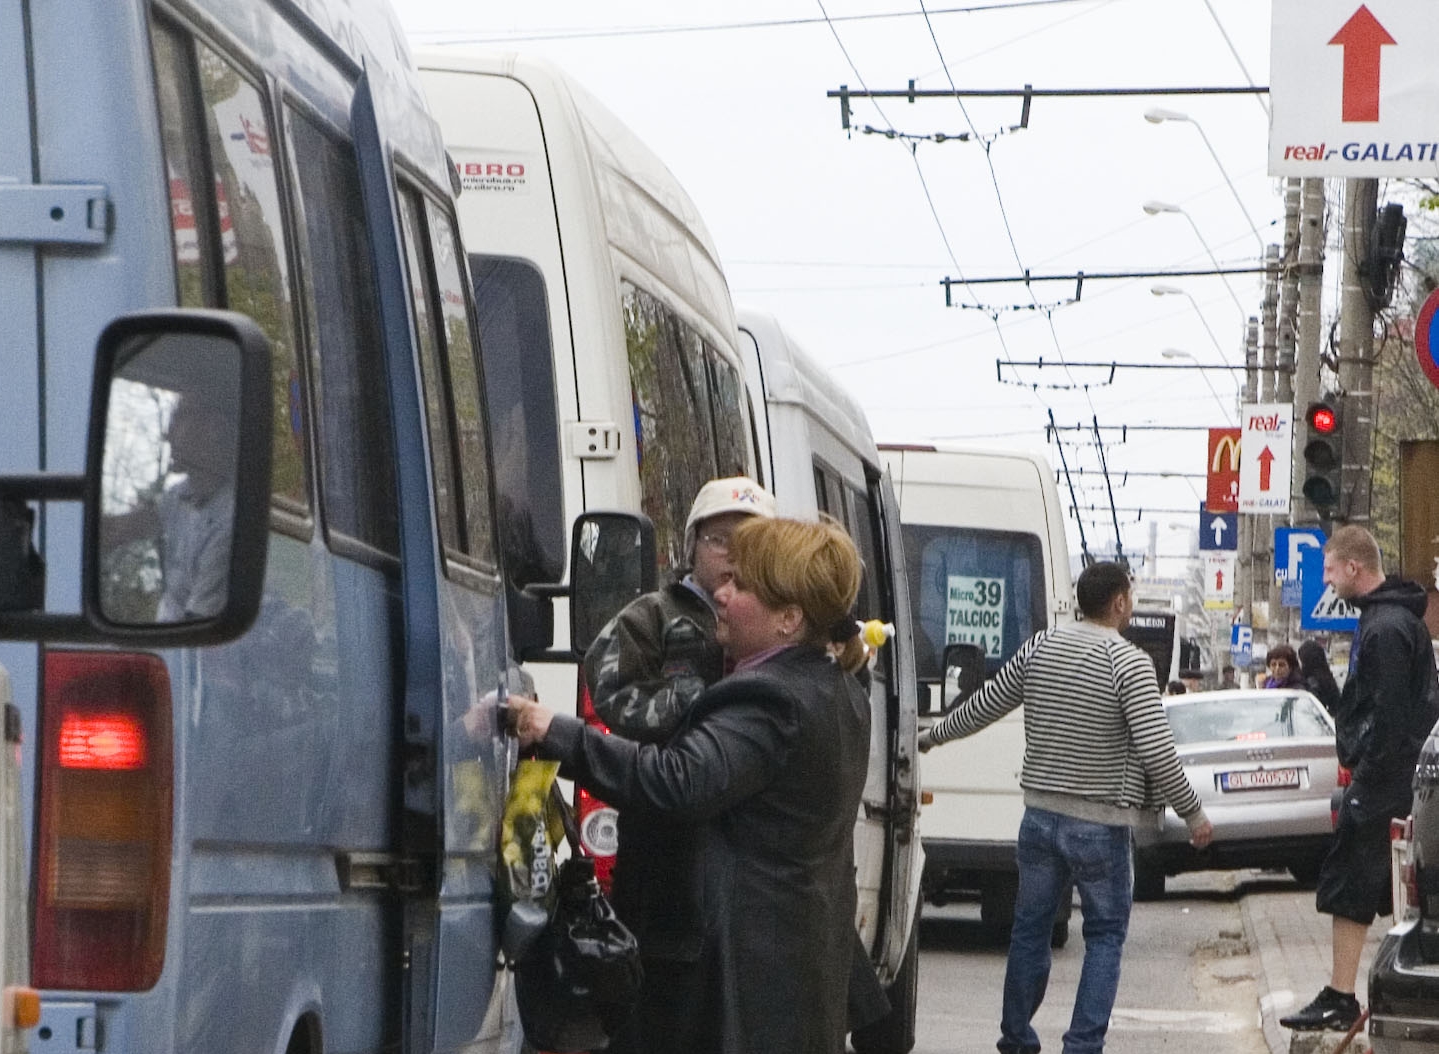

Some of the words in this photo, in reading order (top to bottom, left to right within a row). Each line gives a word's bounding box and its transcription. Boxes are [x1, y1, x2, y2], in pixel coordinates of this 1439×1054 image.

[974, 580, 1002, 607] 39
[949, 609, 1000, 628] TALCIOC
[992, 635, 1000, 655] 2
